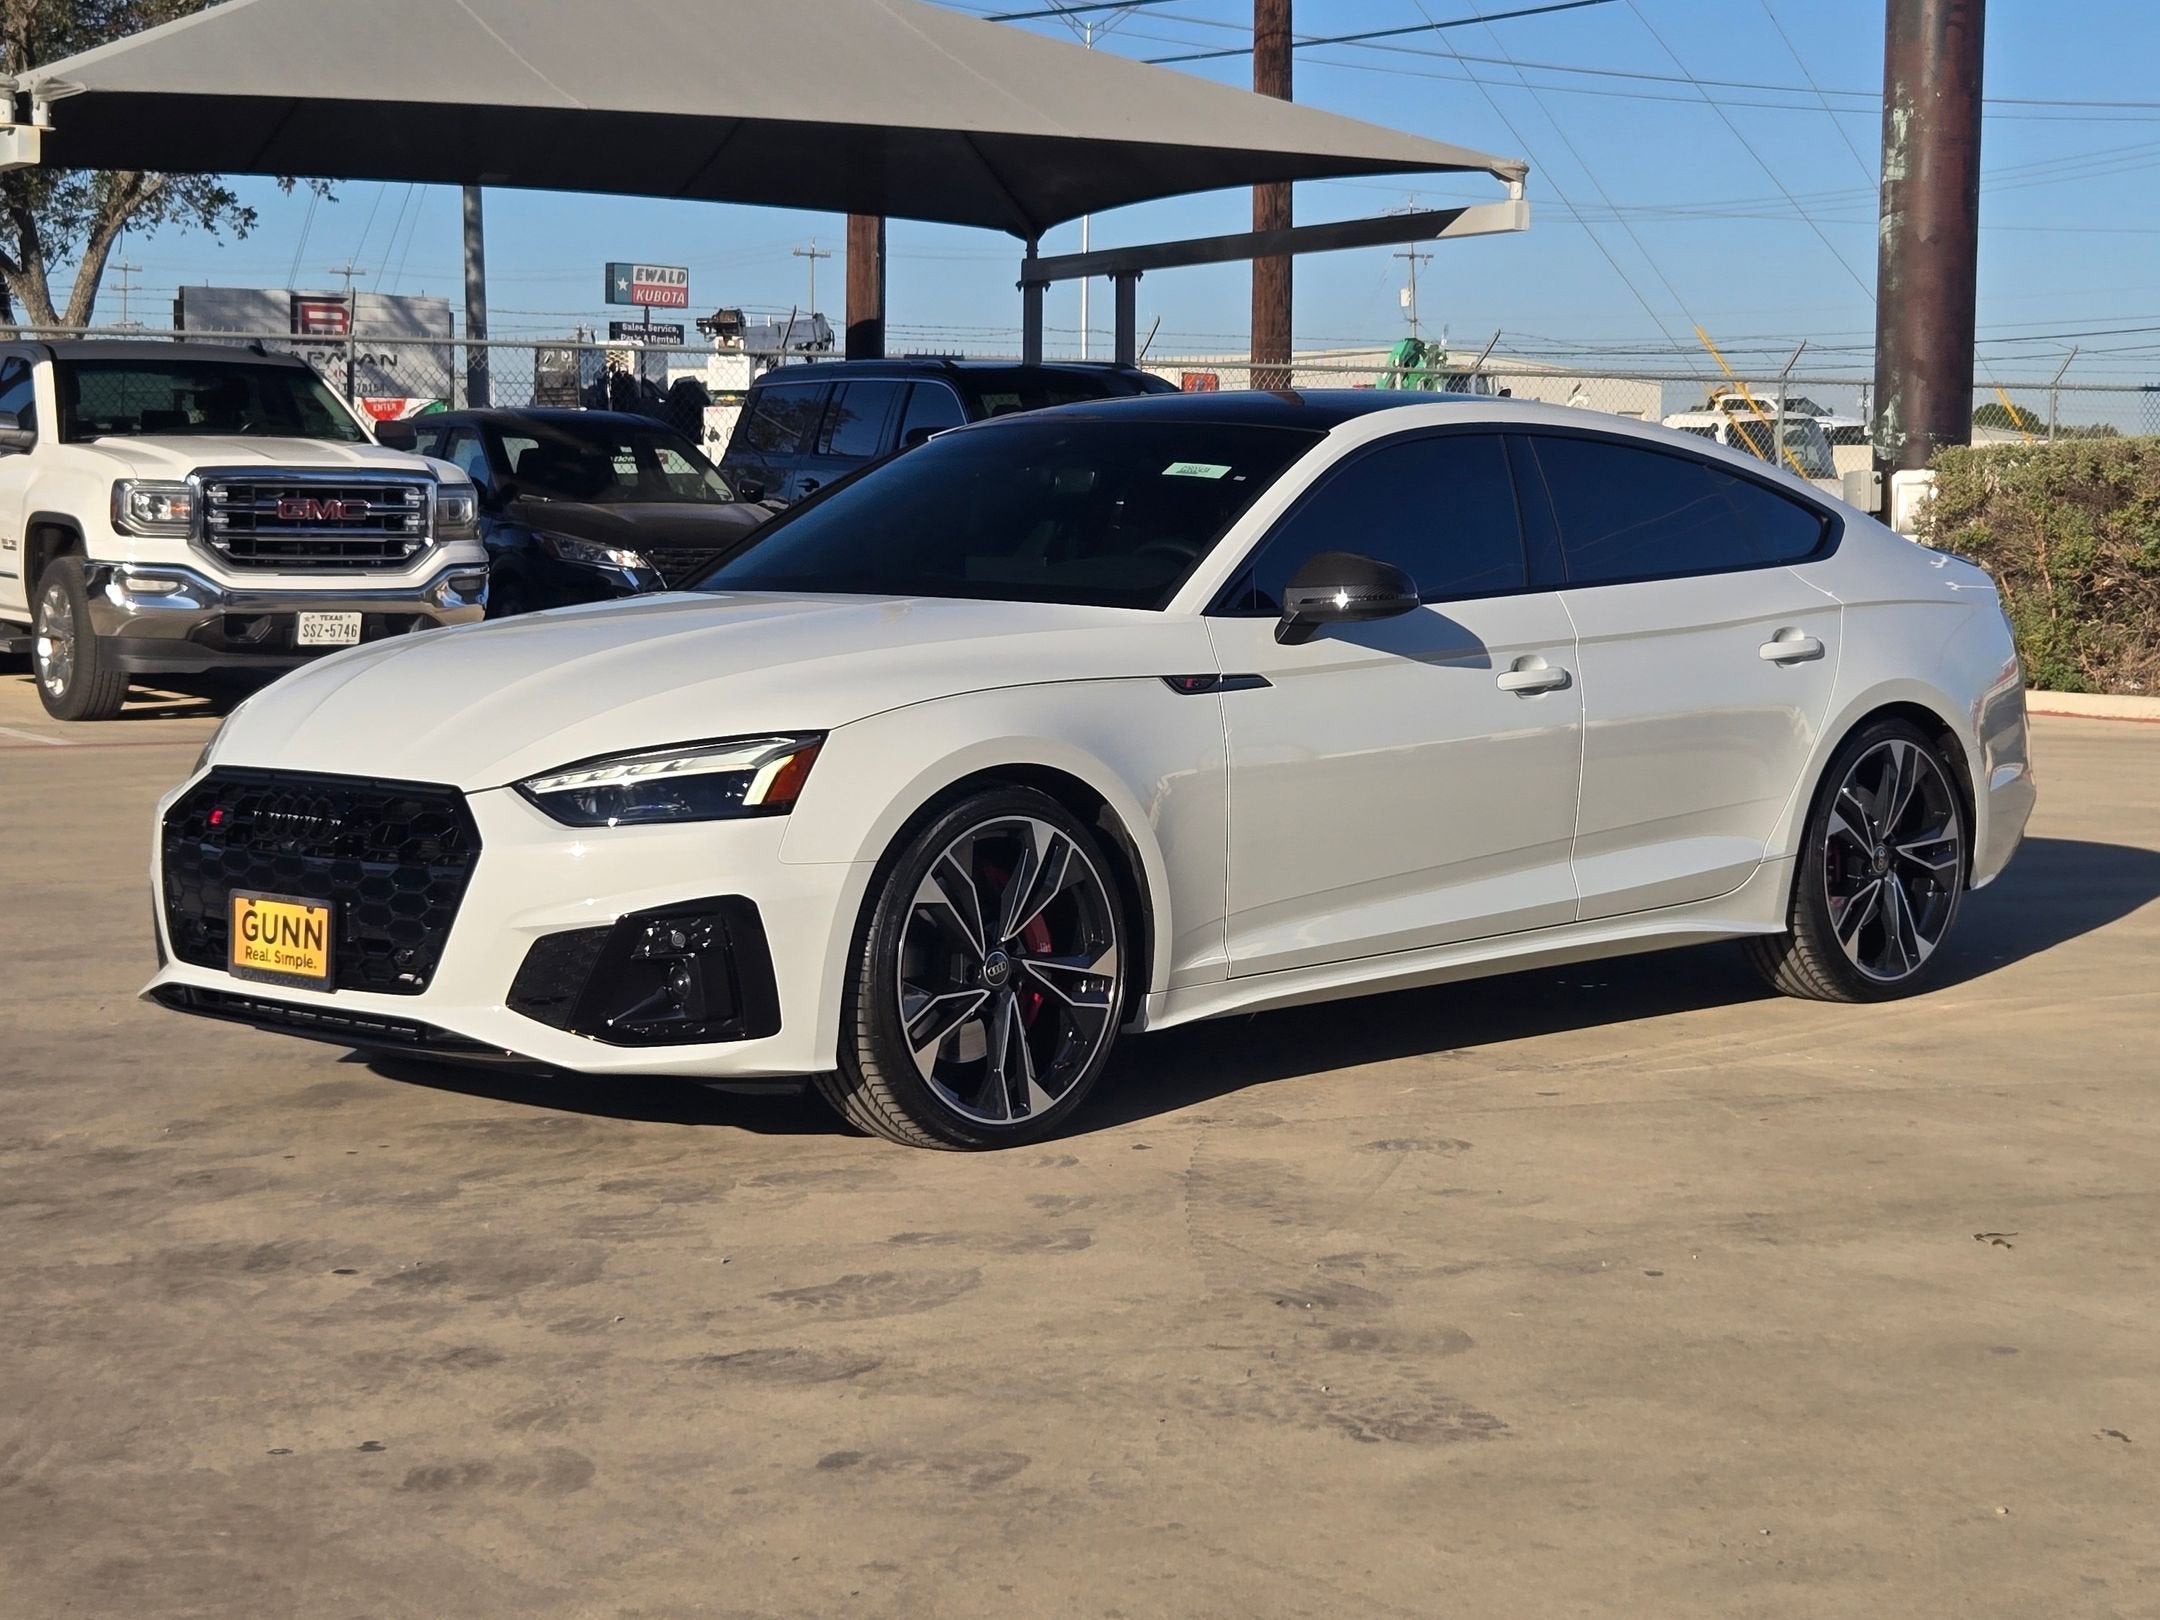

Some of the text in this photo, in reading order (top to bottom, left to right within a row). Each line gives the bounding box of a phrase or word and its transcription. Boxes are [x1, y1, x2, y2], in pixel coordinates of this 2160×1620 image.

[635, 268, 686, 284] EWALD
[636, 289, 685, 305] KUBOTA
[622, 323, 679, 334] Sales, Service,
[650, 335, 681, 345] Rentals
[372, 403, 398, 413] ENTER
[278, 499, 371, 520] GMC
[242, 910, 323, 951] GUNN
[245, 945, 317, 970] Real. Simple.
